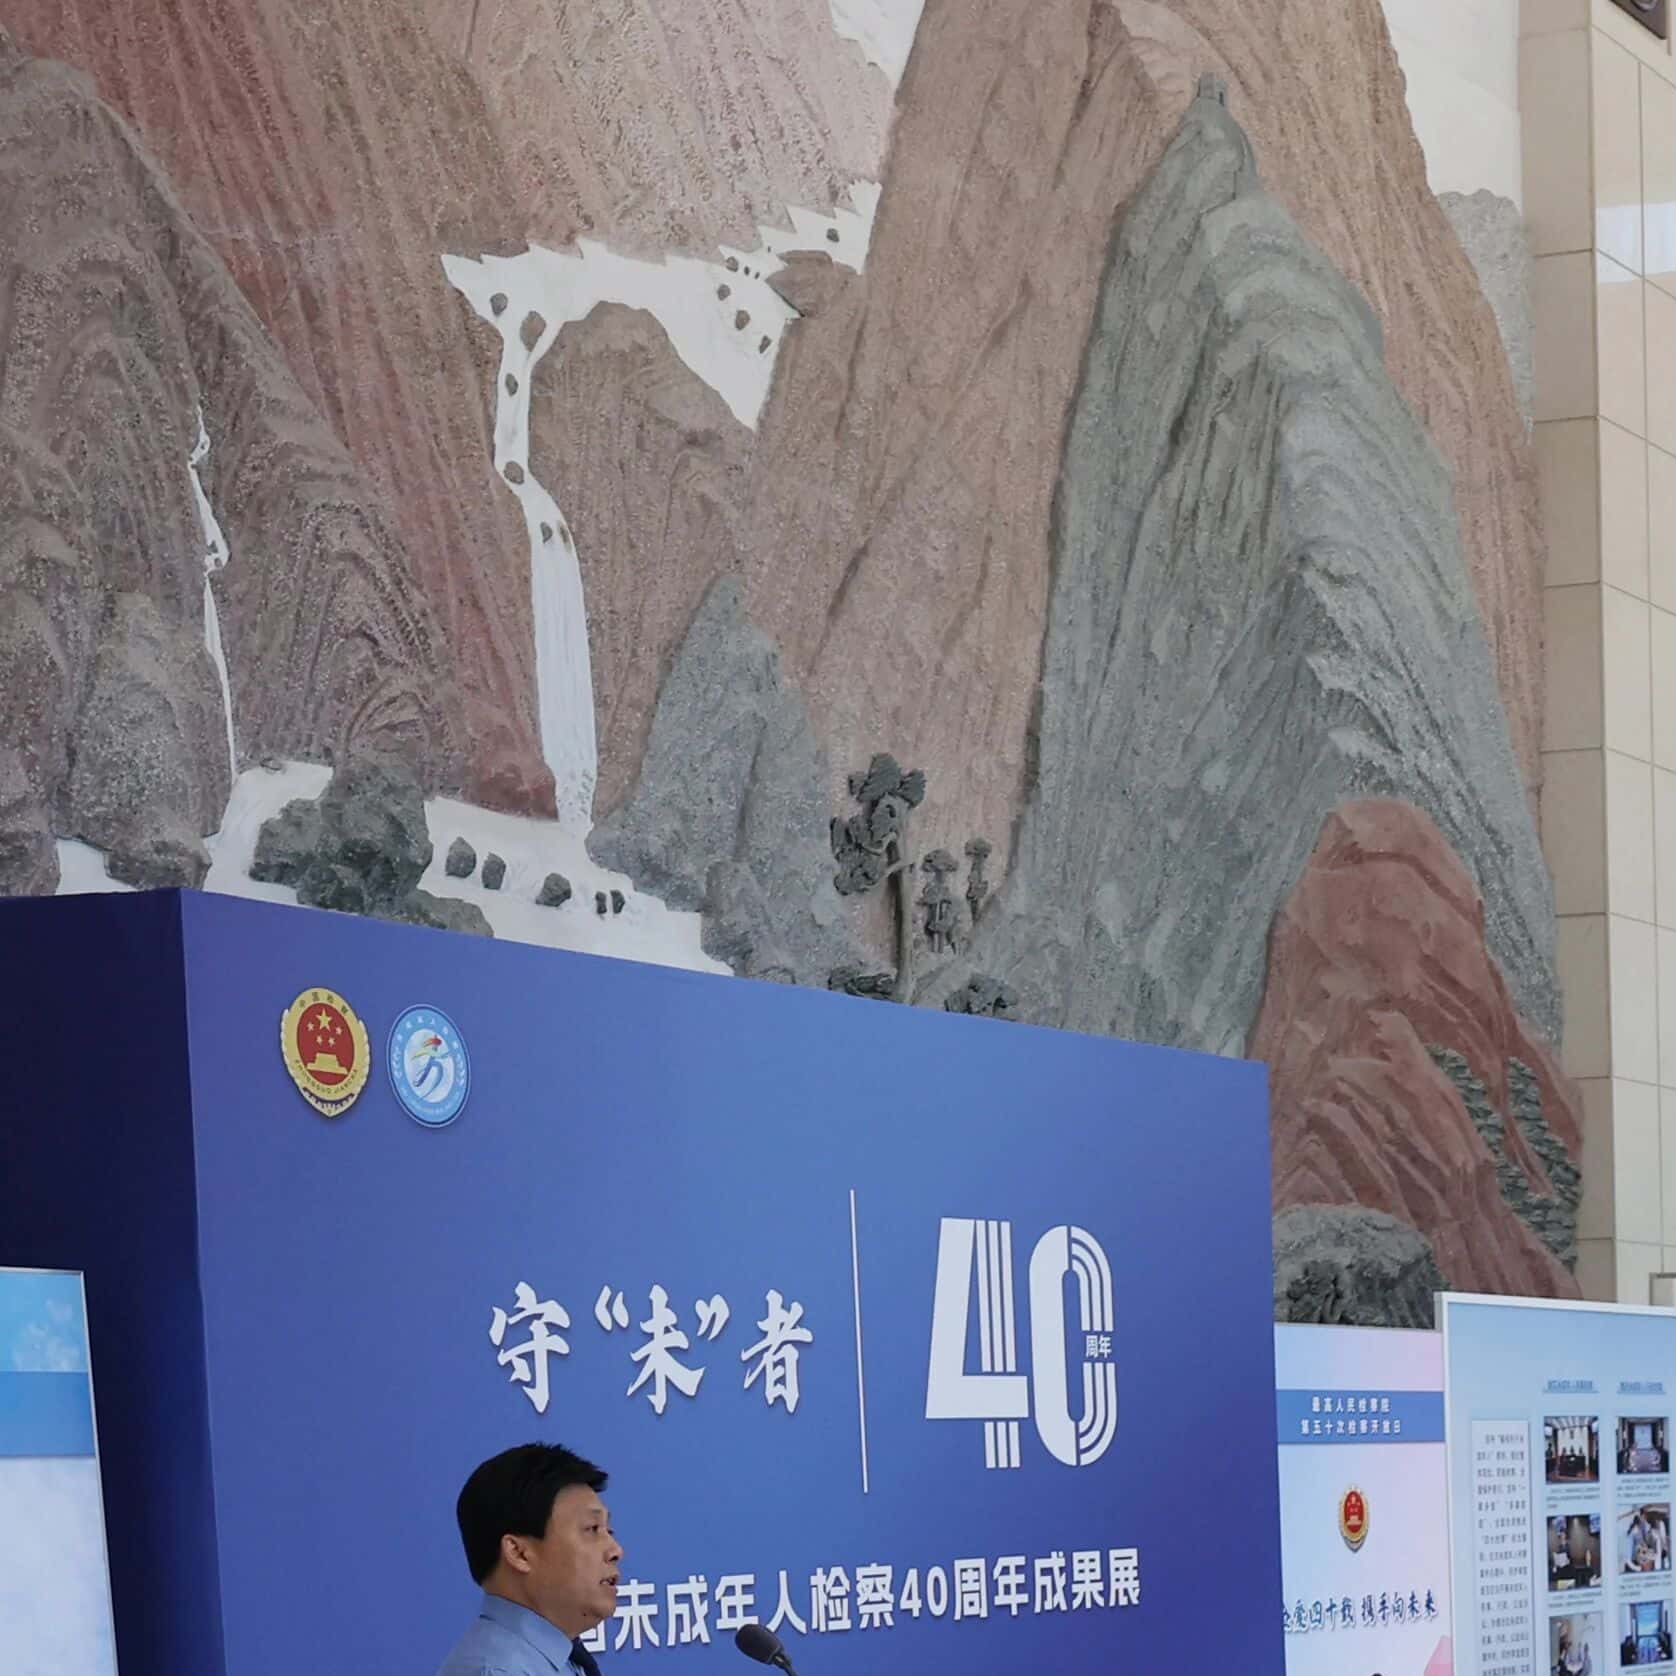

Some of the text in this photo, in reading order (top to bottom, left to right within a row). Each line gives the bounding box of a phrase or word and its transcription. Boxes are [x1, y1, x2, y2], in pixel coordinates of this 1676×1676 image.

[488, 1280, 814, 1415] 守“未”者
[925, 1217, 1118, 1468] 40
[1085, 1334, 1113, 1359] 周年
